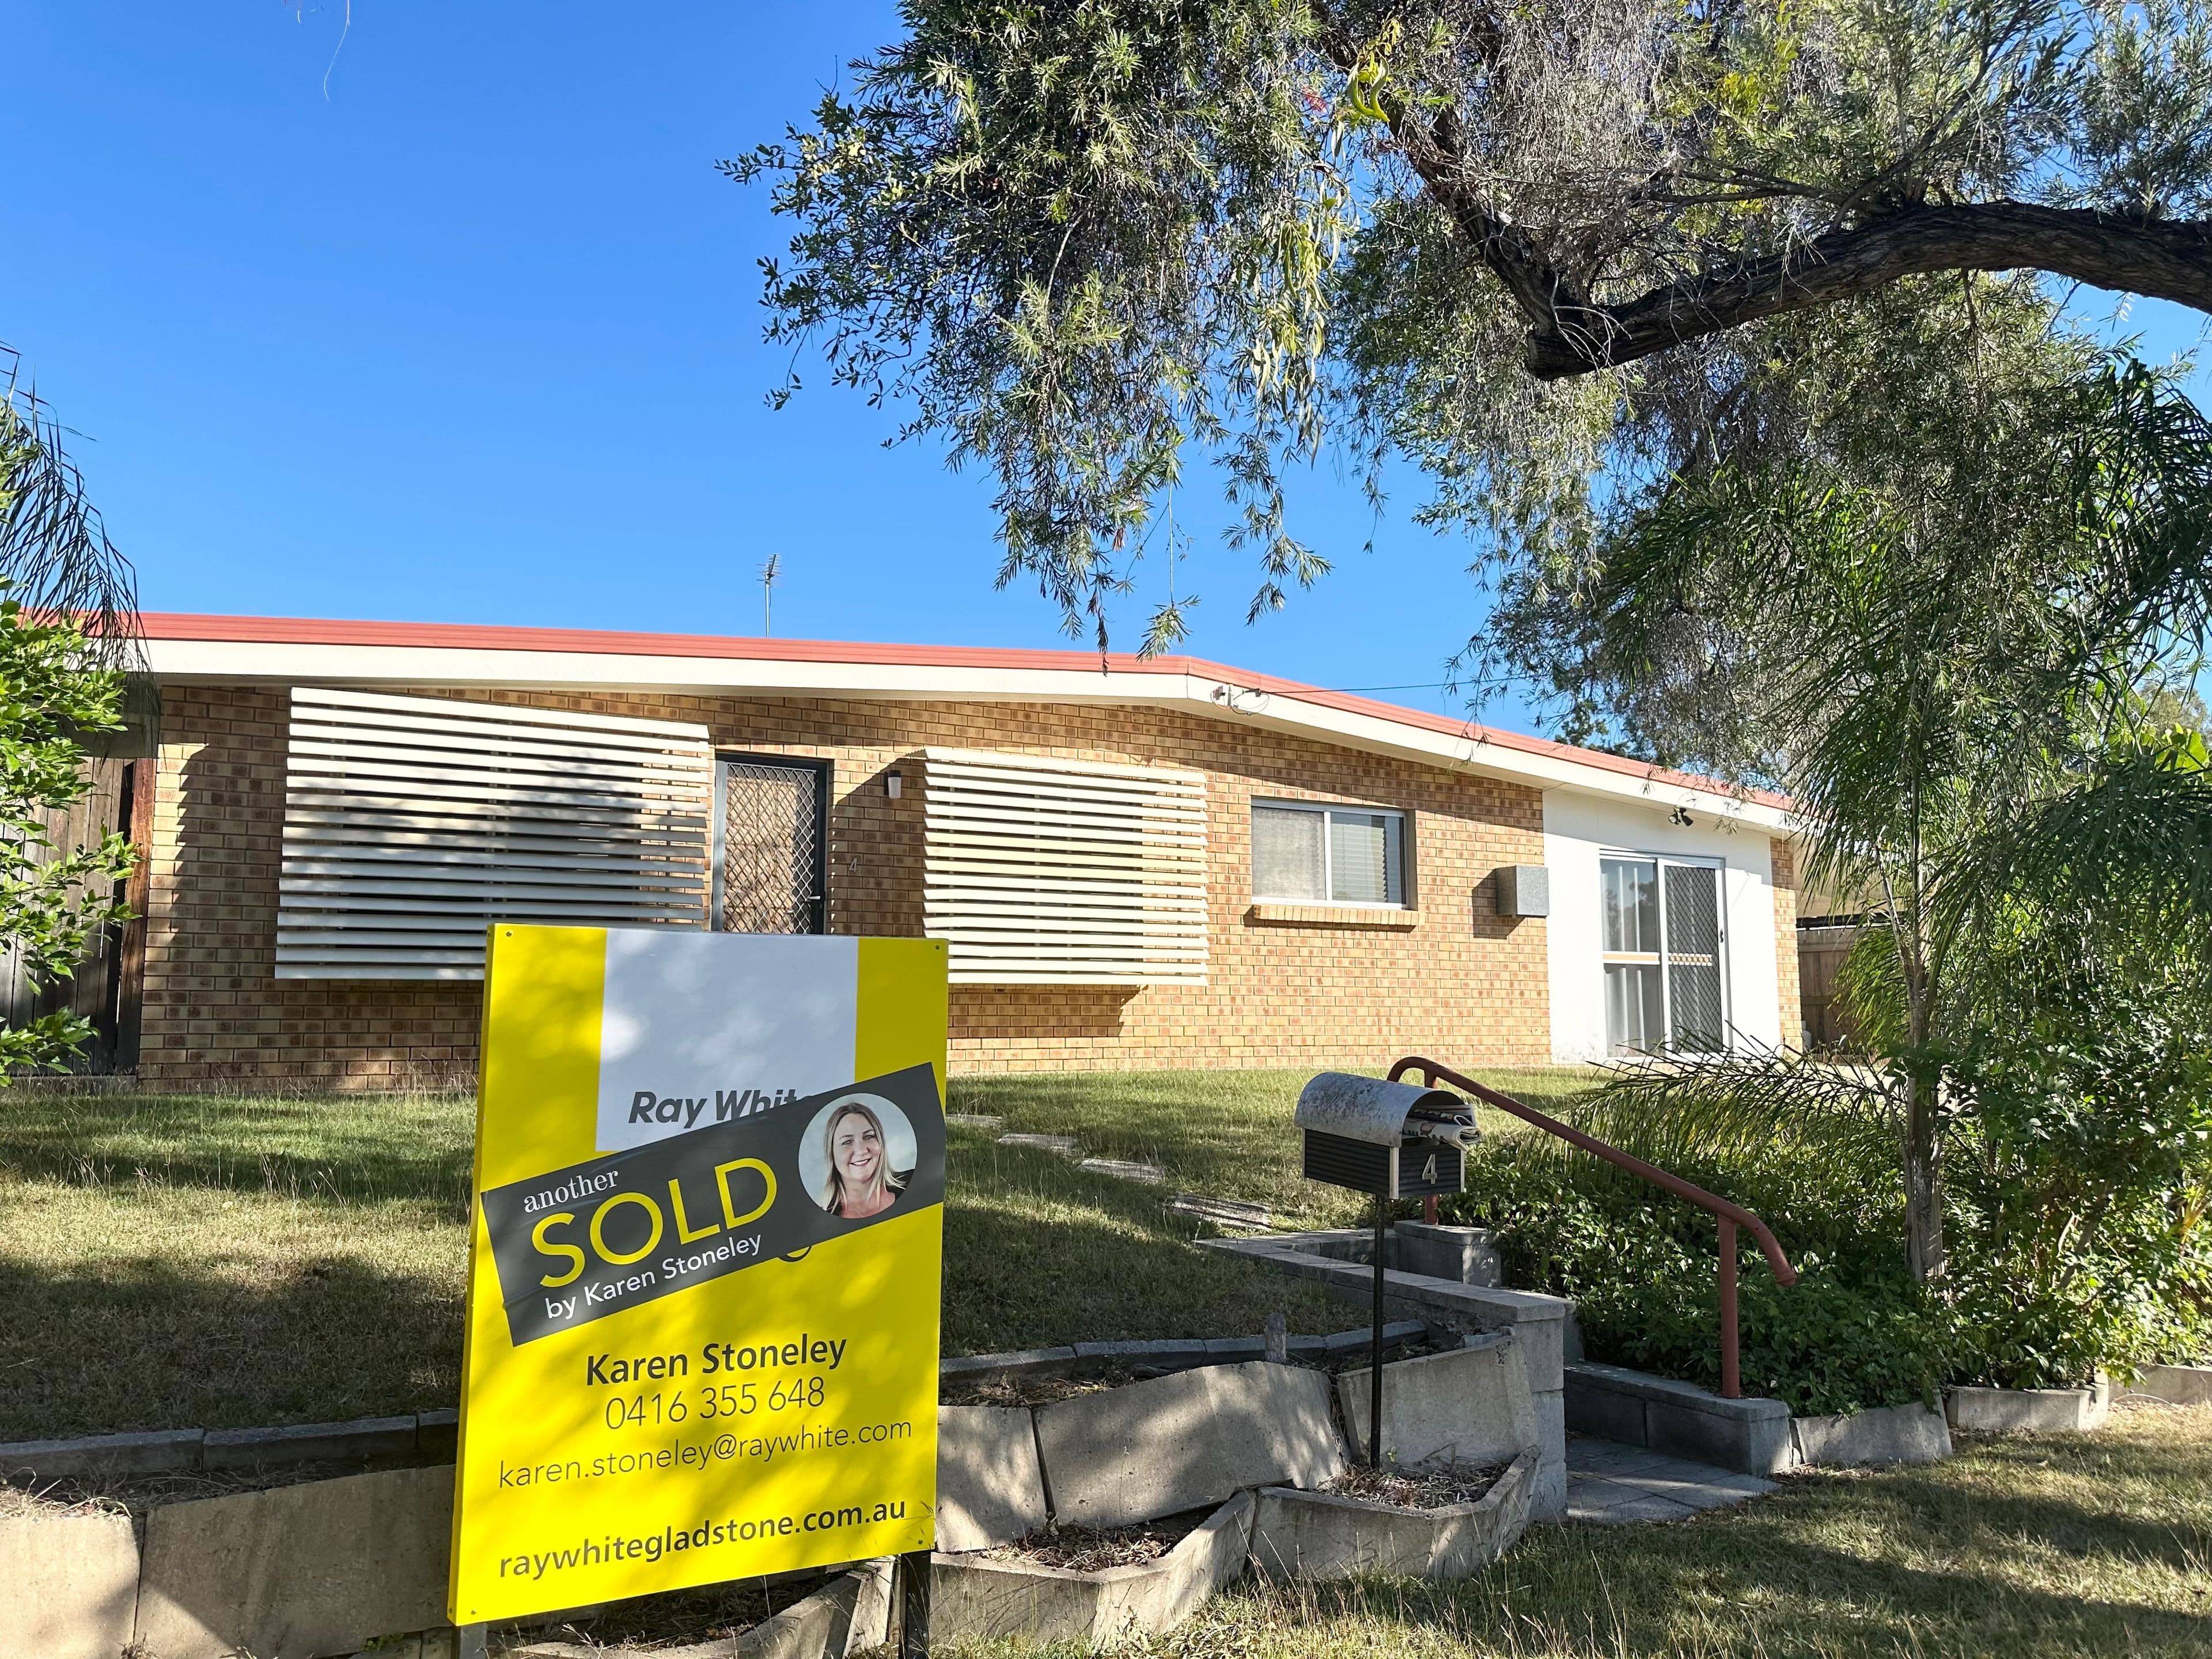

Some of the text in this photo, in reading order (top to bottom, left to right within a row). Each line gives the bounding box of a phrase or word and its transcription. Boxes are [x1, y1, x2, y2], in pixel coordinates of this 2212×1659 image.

[849, 857, 857, 873] 4
[628, 1089, 813, 1129] Ray Whit
[524, 1170, 619, 1213] another
[1422, 1153, 1438, 1185] 4
[531, 1157, 778, 1288] SOLD
[545, 1296, 577, 1320] by
[584, 1271, 656, 1306] Karen
[662, 1234, 762, 1279] Stoneley
[586, 1333, 847, 1386] Karen Stoneley
[605, 1376, 825, 1429] 0416 355 648
[499, 1418, 912, 1488] karen.stoneley@raywhite.com
[499, 1500, 906, 1581] raywhitegladstone.com.au
